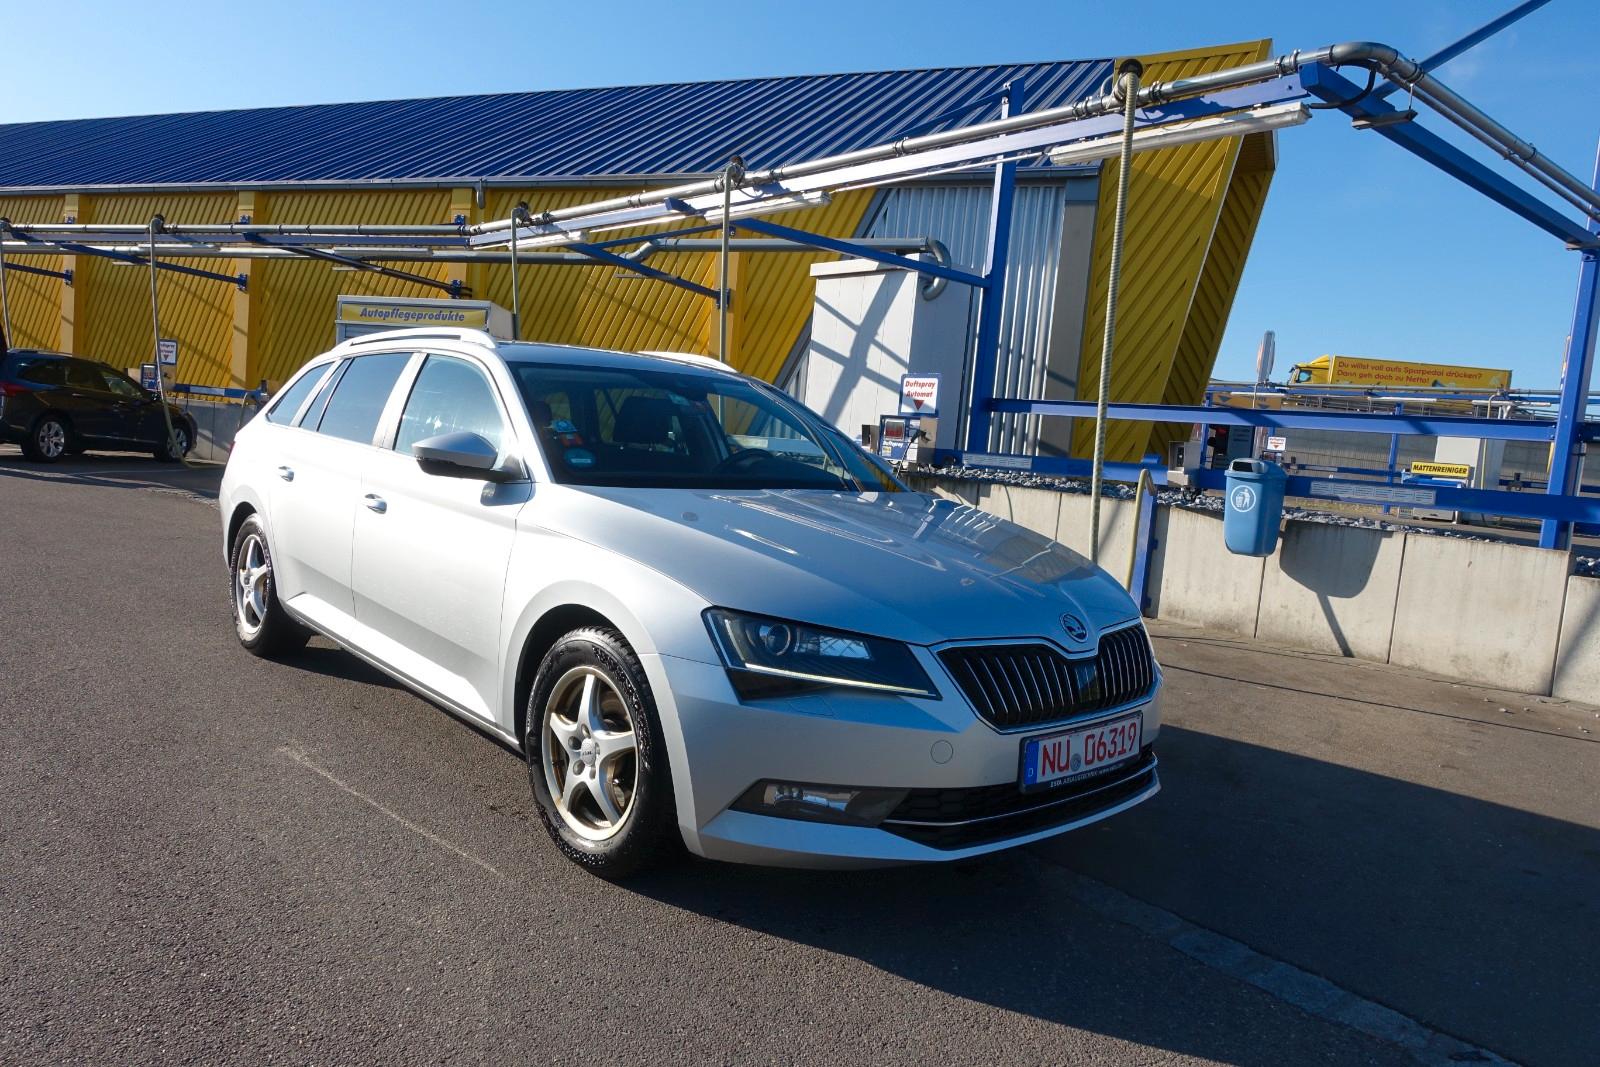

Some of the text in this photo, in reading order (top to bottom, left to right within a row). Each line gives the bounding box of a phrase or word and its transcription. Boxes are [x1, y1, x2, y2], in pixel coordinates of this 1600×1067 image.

[360, 307, 465, 322] Autopflegeprodukte
[1337, 369, 1357, 377] Dann
[1375, 373, 1393, 381] doch
[1406, 375, 1430, 384] Netto!
[1404, 366, 1444, 377] Sparpedal
[905, 381, 936, 389] Duftspray
[1412, 465, 1467, 474] MATTENREINIGER
[1041, 739, 1071, 777] NU
[1084, 722, 1137, 766] 06319
